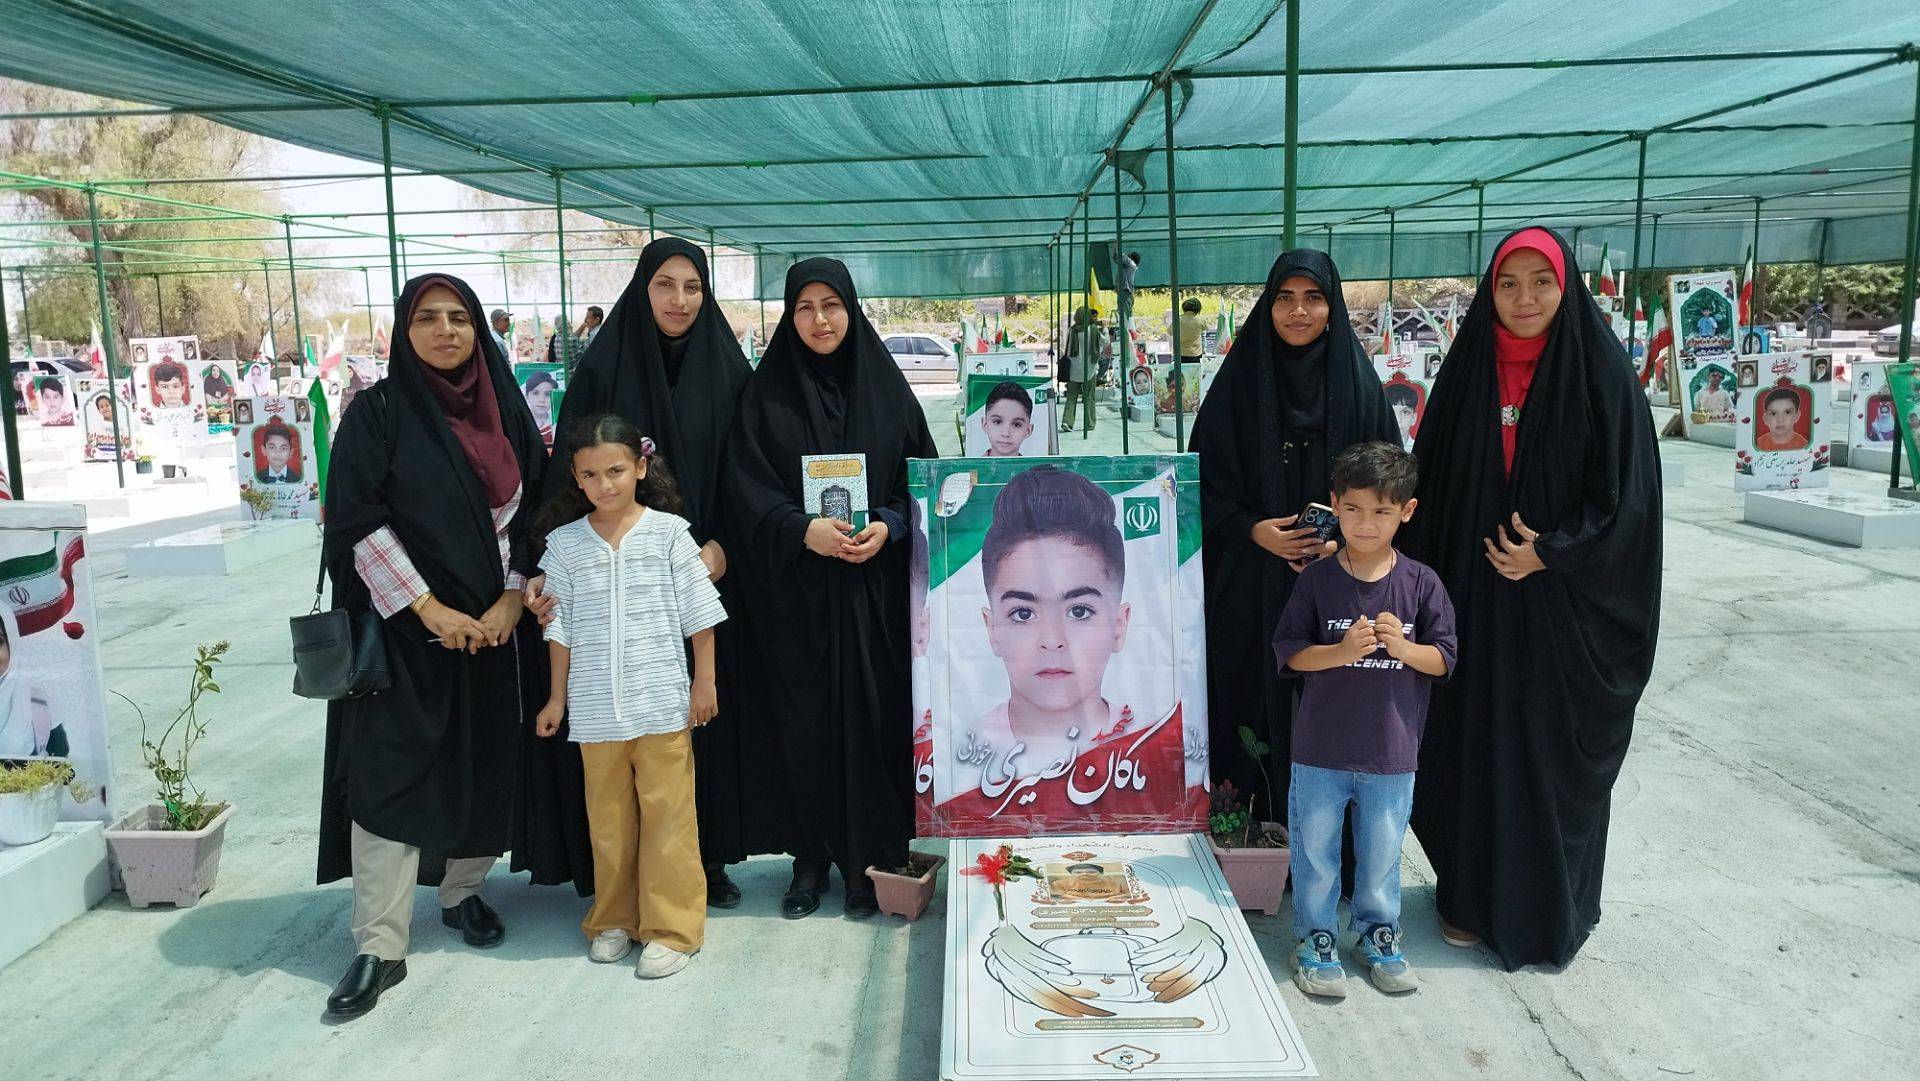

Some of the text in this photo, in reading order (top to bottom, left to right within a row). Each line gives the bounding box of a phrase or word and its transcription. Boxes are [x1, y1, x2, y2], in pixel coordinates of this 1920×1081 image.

[1067, 699, 1182, 805] ماکان
[1091, 704, 1135, 741] شهید
[980, 726, 1080, 819] نصیری
